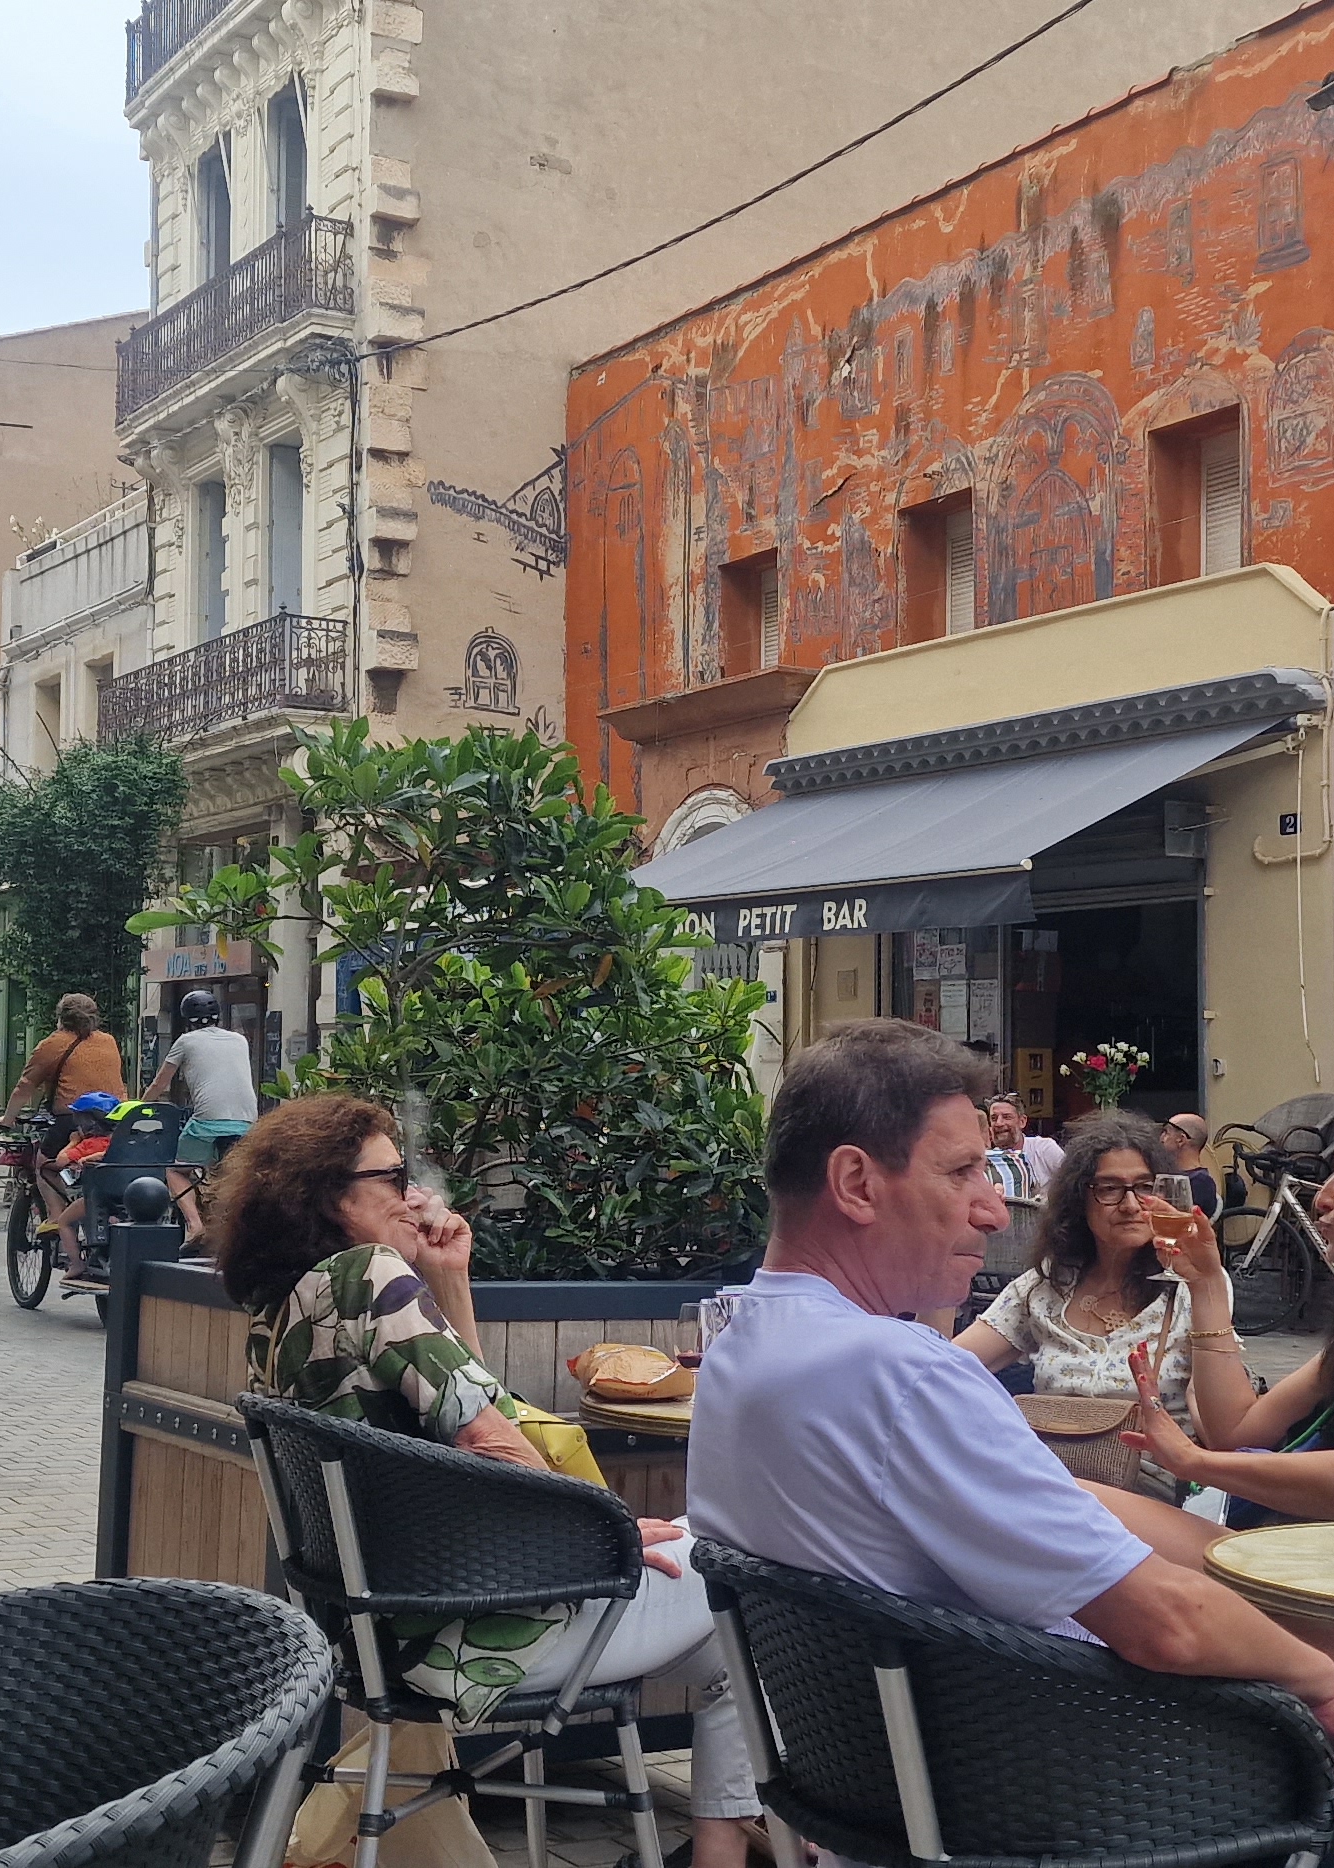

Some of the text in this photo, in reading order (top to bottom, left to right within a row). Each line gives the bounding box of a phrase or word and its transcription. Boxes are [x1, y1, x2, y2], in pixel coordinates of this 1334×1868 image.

[1285, 815, 1295, 833] 2
[737, 903, 798, 937] PETIT
[822, 898, 868, 931] BAR
